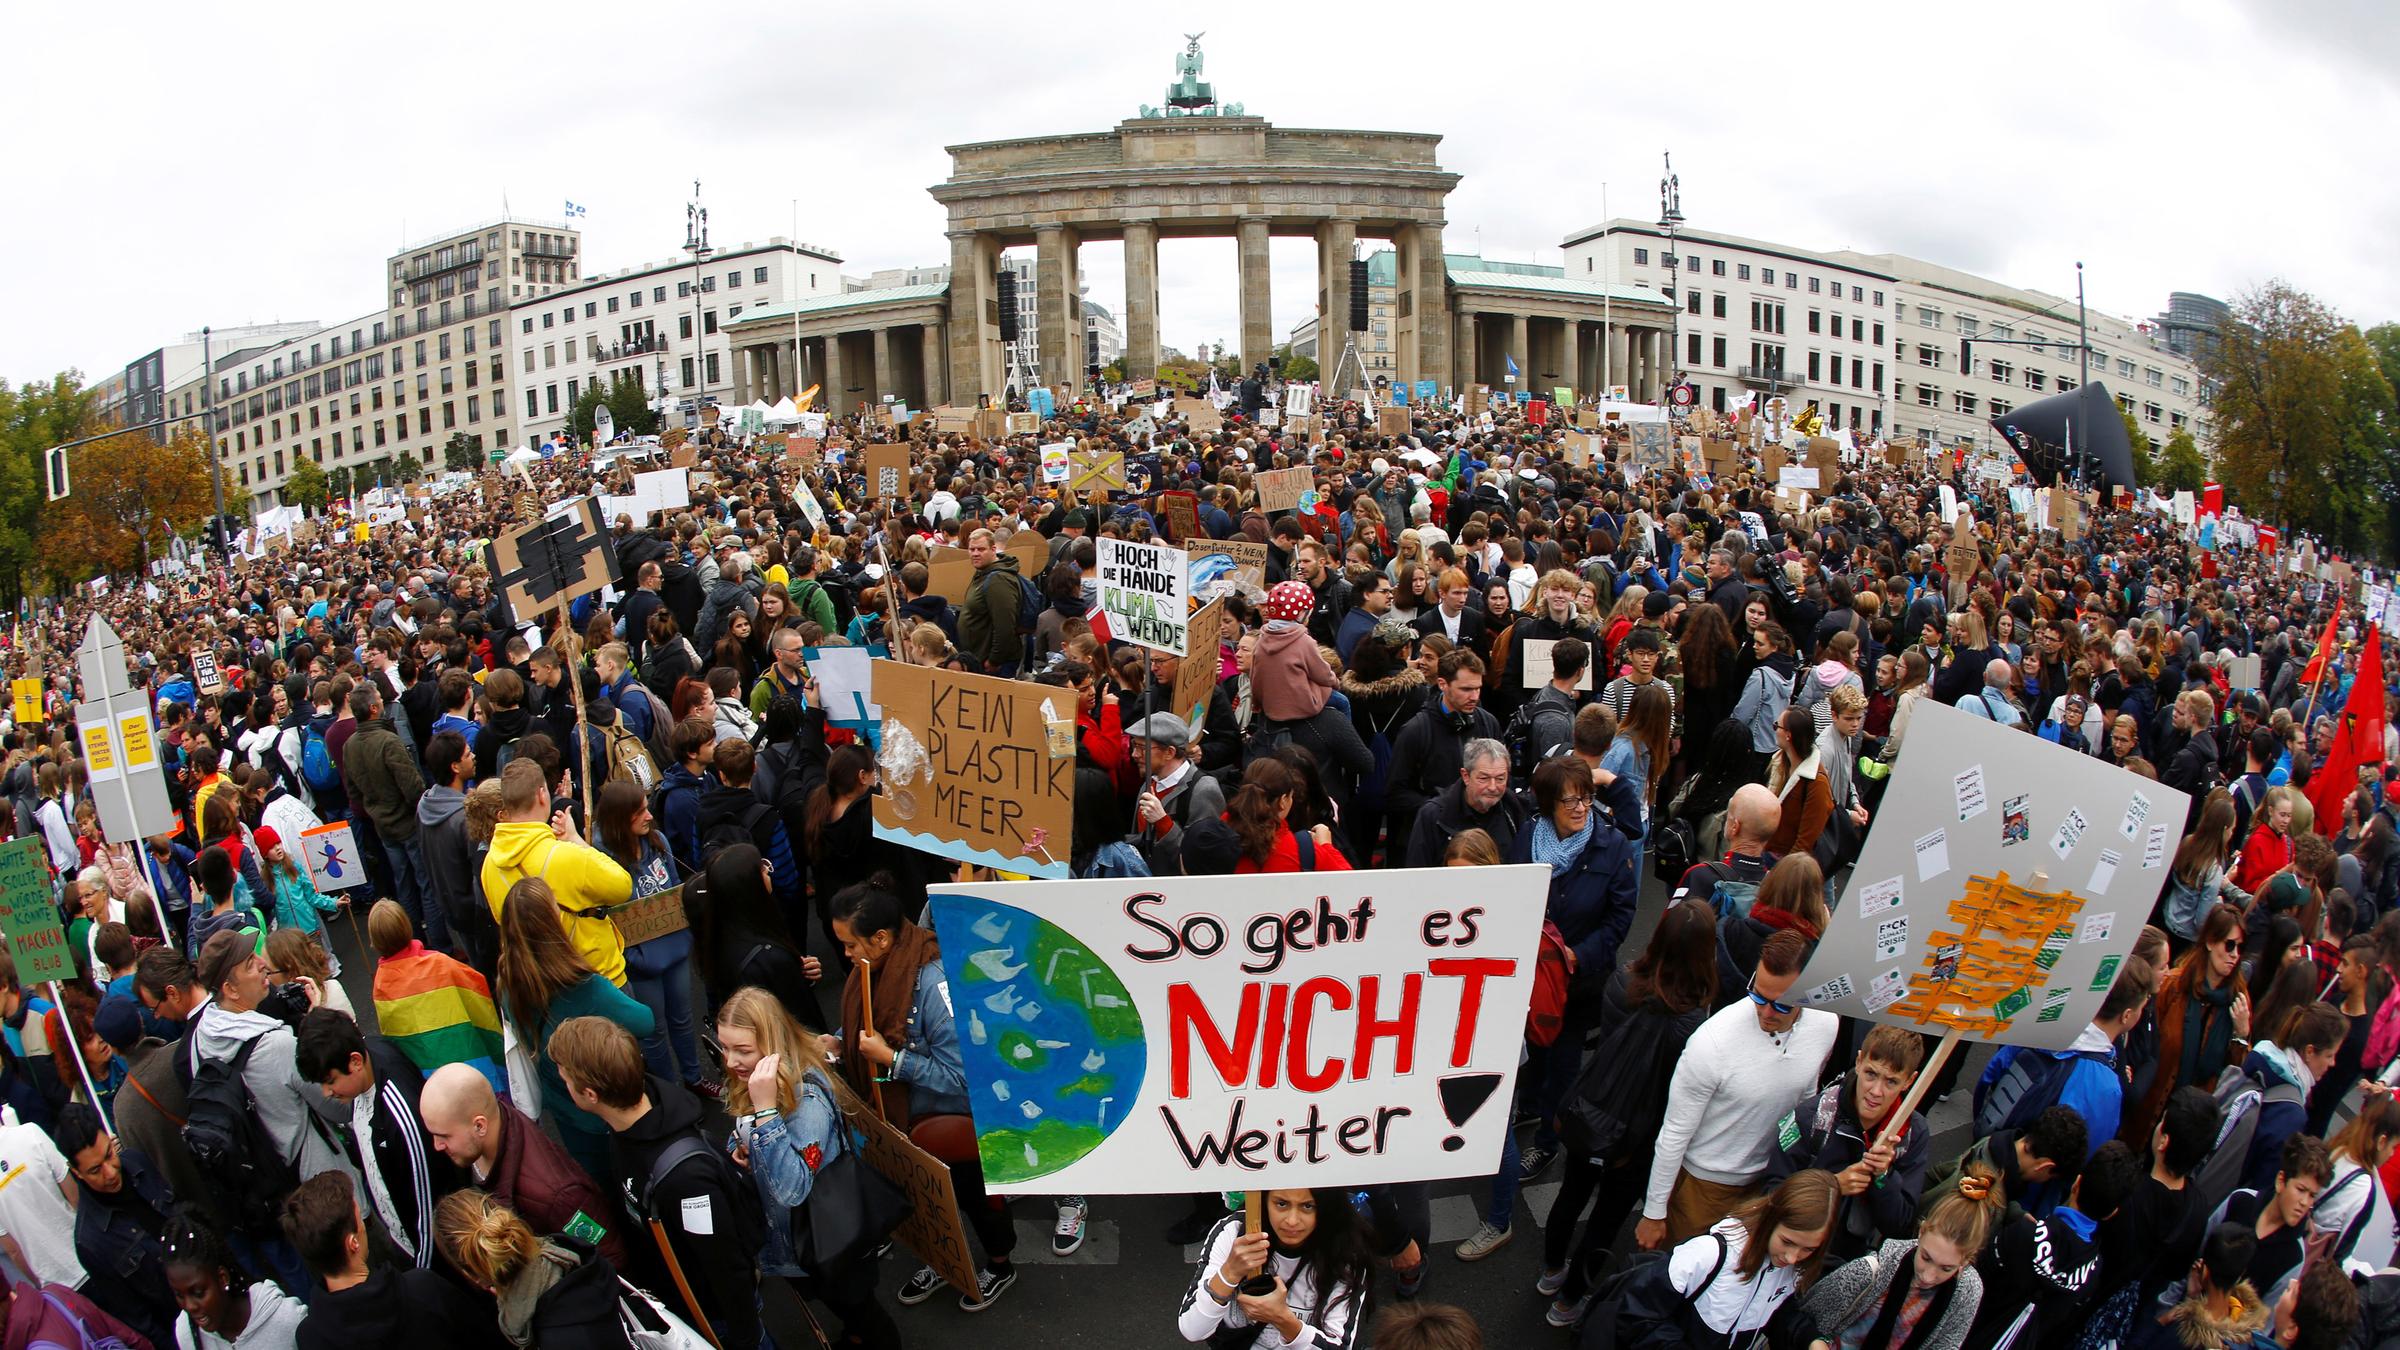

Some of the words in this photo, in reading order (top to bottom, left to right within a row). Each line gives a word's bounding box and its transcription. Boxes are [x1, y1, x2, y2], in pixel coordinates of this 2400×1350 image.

[1114, 543, 1159, 571] HOCH
[1103, 566, 1117, 581] DIE
[1120, 565, 1176, 597] HÄNDE
[1104, 585, 1158, 622] KLIMA
[1126, 616, 1186, 651] WENDE
[197, 655, 213, 668] EIS
[201, 675, 220, 687] ALLE
[931, 679, 1013, 738] KEIN
[928, 728, 1070, 801] PLASTIK
[934, 782, 1026, 845] MEER
[16, 927, 64, 956] MACHEN
[1124, 892, 1228, 961] So
[1241, 894, 1376, 974] geht
[1421, 905, 1487, 947] es
[1878, 928, 1907, 941] CLIMATE
[1878, 934, 1907, 949] CRISIS
[33, 953, 62, 972] BLUB
[1827, 980, 1843, 1000] LOVE
[1838, 975, 1852, 997] MAKE
[1166, 956, 1518, 1101] NICHT
[1159, 1096, 1412, 1171] Weiter
